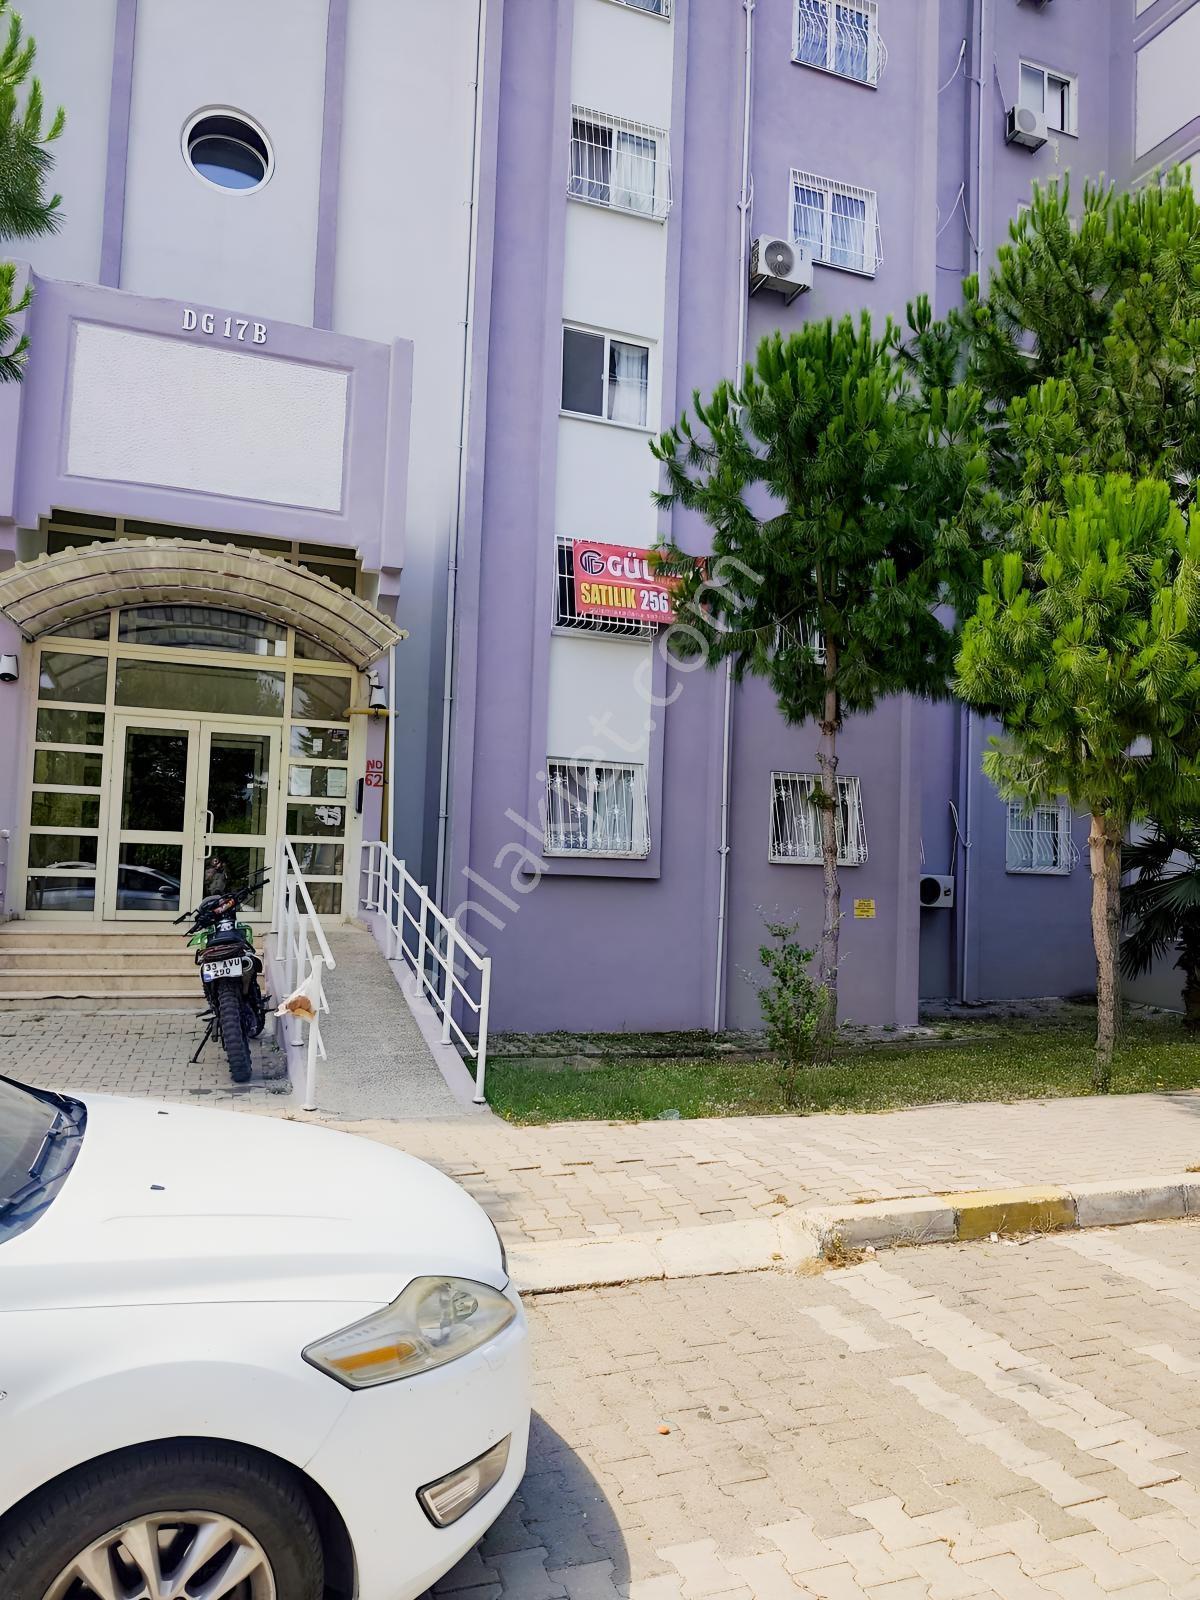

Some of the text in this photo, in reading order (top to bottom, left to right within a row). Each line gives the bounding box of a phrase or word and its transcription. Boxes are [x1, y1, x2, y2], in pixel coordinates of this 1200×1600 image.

[182, 309, 267, 344] DG 17B
[607, 552, 668, 581] GÜL
[580, 582, 669, 613] SATILIK 256
[365, 774, 384, 788] 62
[205, 958, 240, 972] 33 AVU
